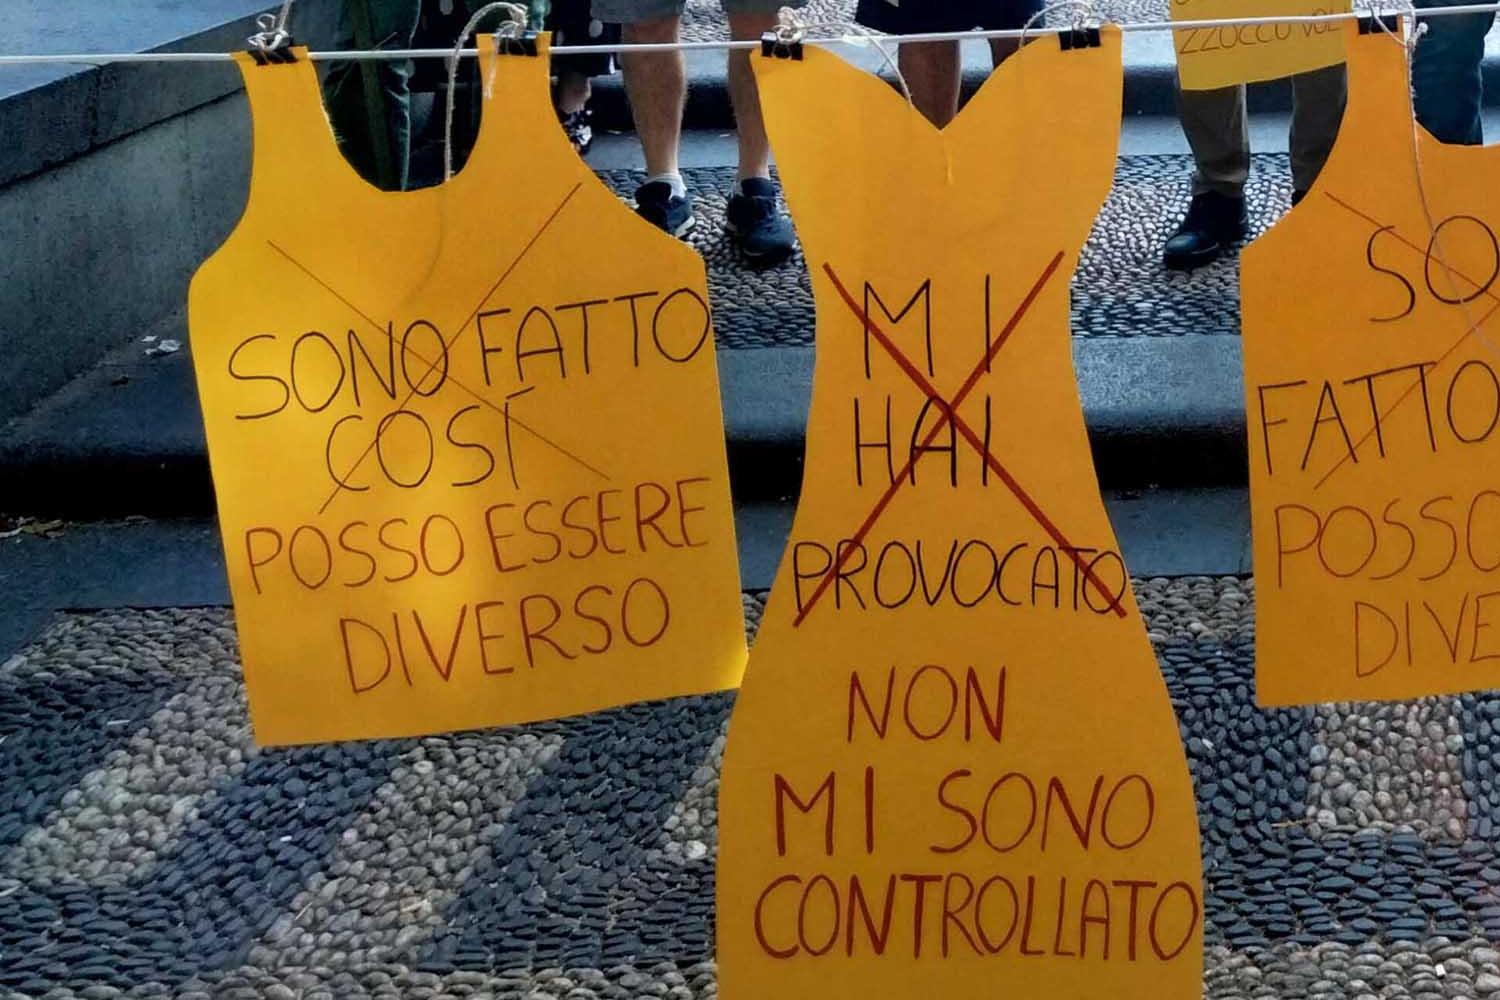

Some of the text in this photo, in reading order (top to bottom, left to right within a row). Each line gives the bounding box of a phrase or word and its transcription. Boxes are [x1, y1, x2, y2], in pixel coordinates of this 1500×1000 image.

[229, 287, 711, 420] SONO FATTO
[863, 274, 993, 379] MI
[853, 395, 992, 489] HAI
[245, 478, 711, 595] POSSO ESSERE
[792, 540, 1128, 615] PROVOCATO
[340, 577, 670, 694] DIVERSO
[847, 665, 1007, 743] NON
[773, 766, 1156, 857] MI SONO
[754, 873, 1200, 962] CONTROLLATO
